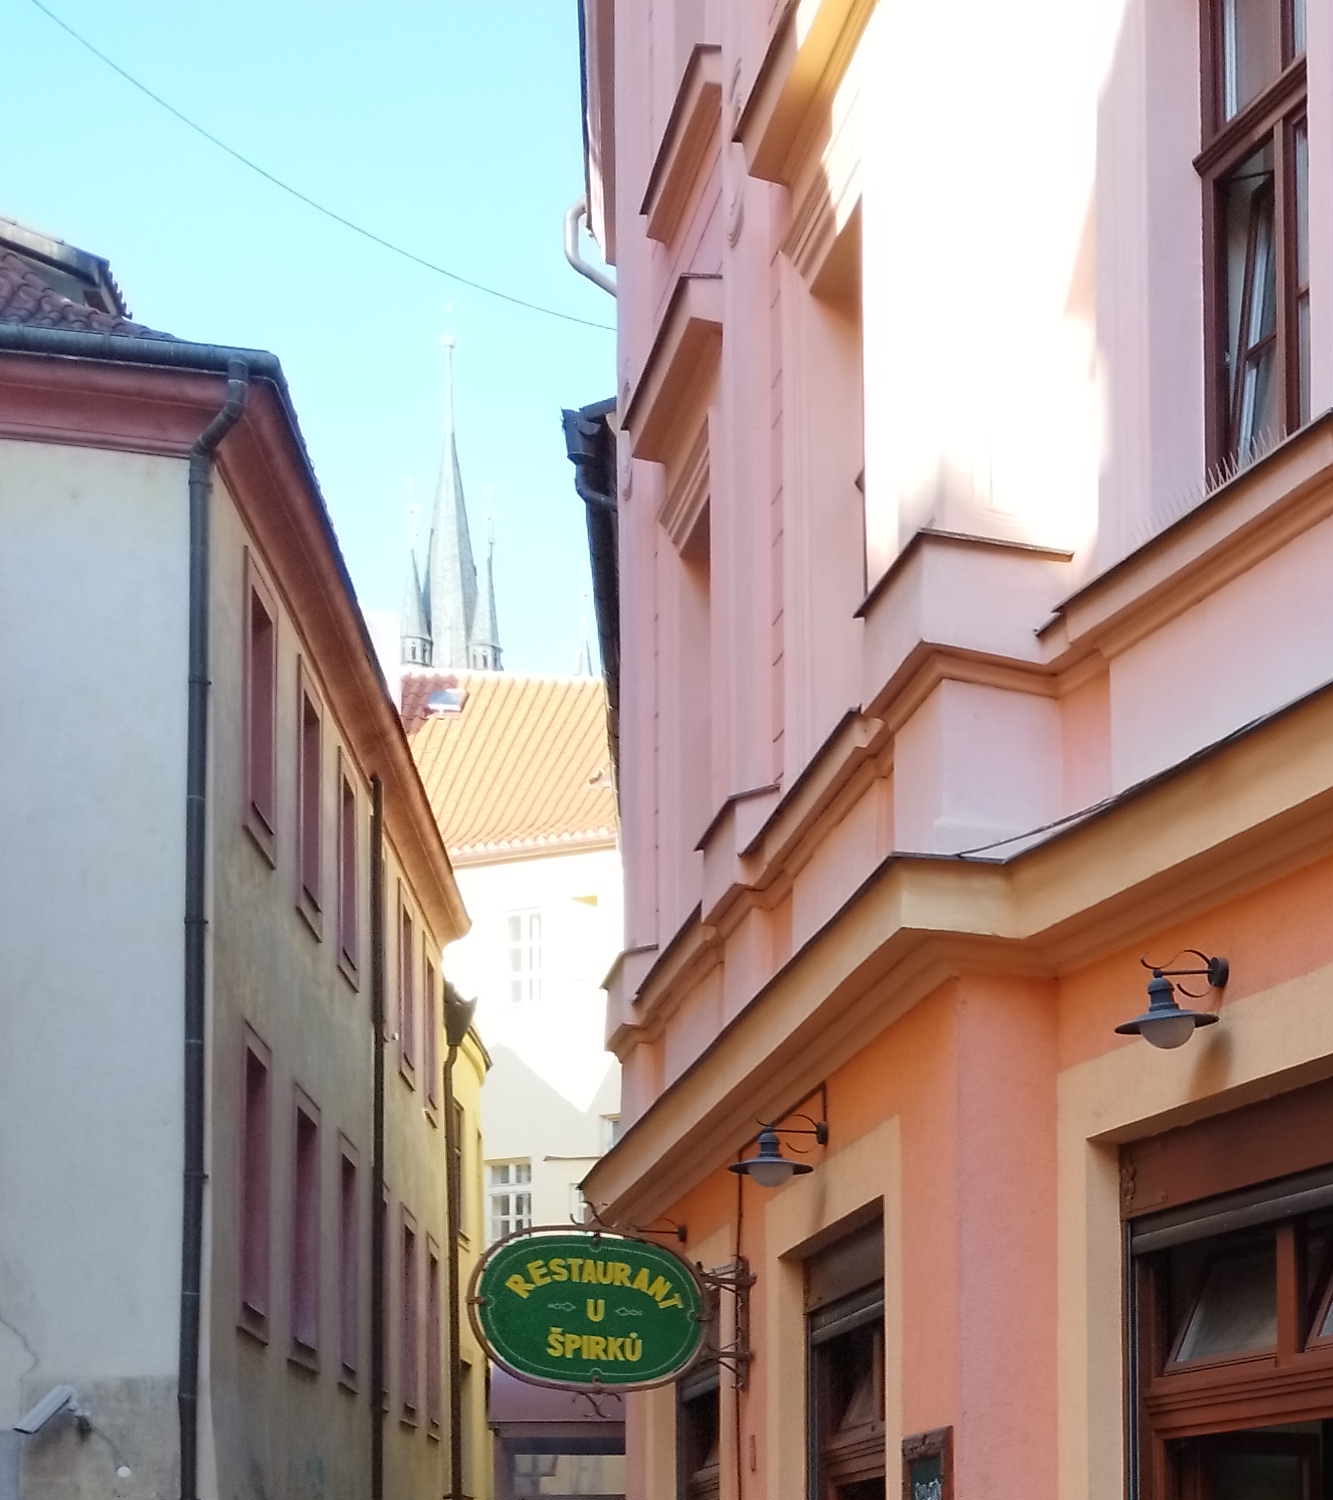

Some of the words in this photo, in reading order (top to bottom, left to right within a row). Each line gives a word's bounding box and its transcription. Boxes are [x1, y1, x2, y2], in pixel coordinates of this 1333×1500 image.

[505, 1258, 684, 1310] RESTAURANT
[585, 1298, 606, 1322] U
[546, 1326, 643, 1362] ŠPIRKŮ
